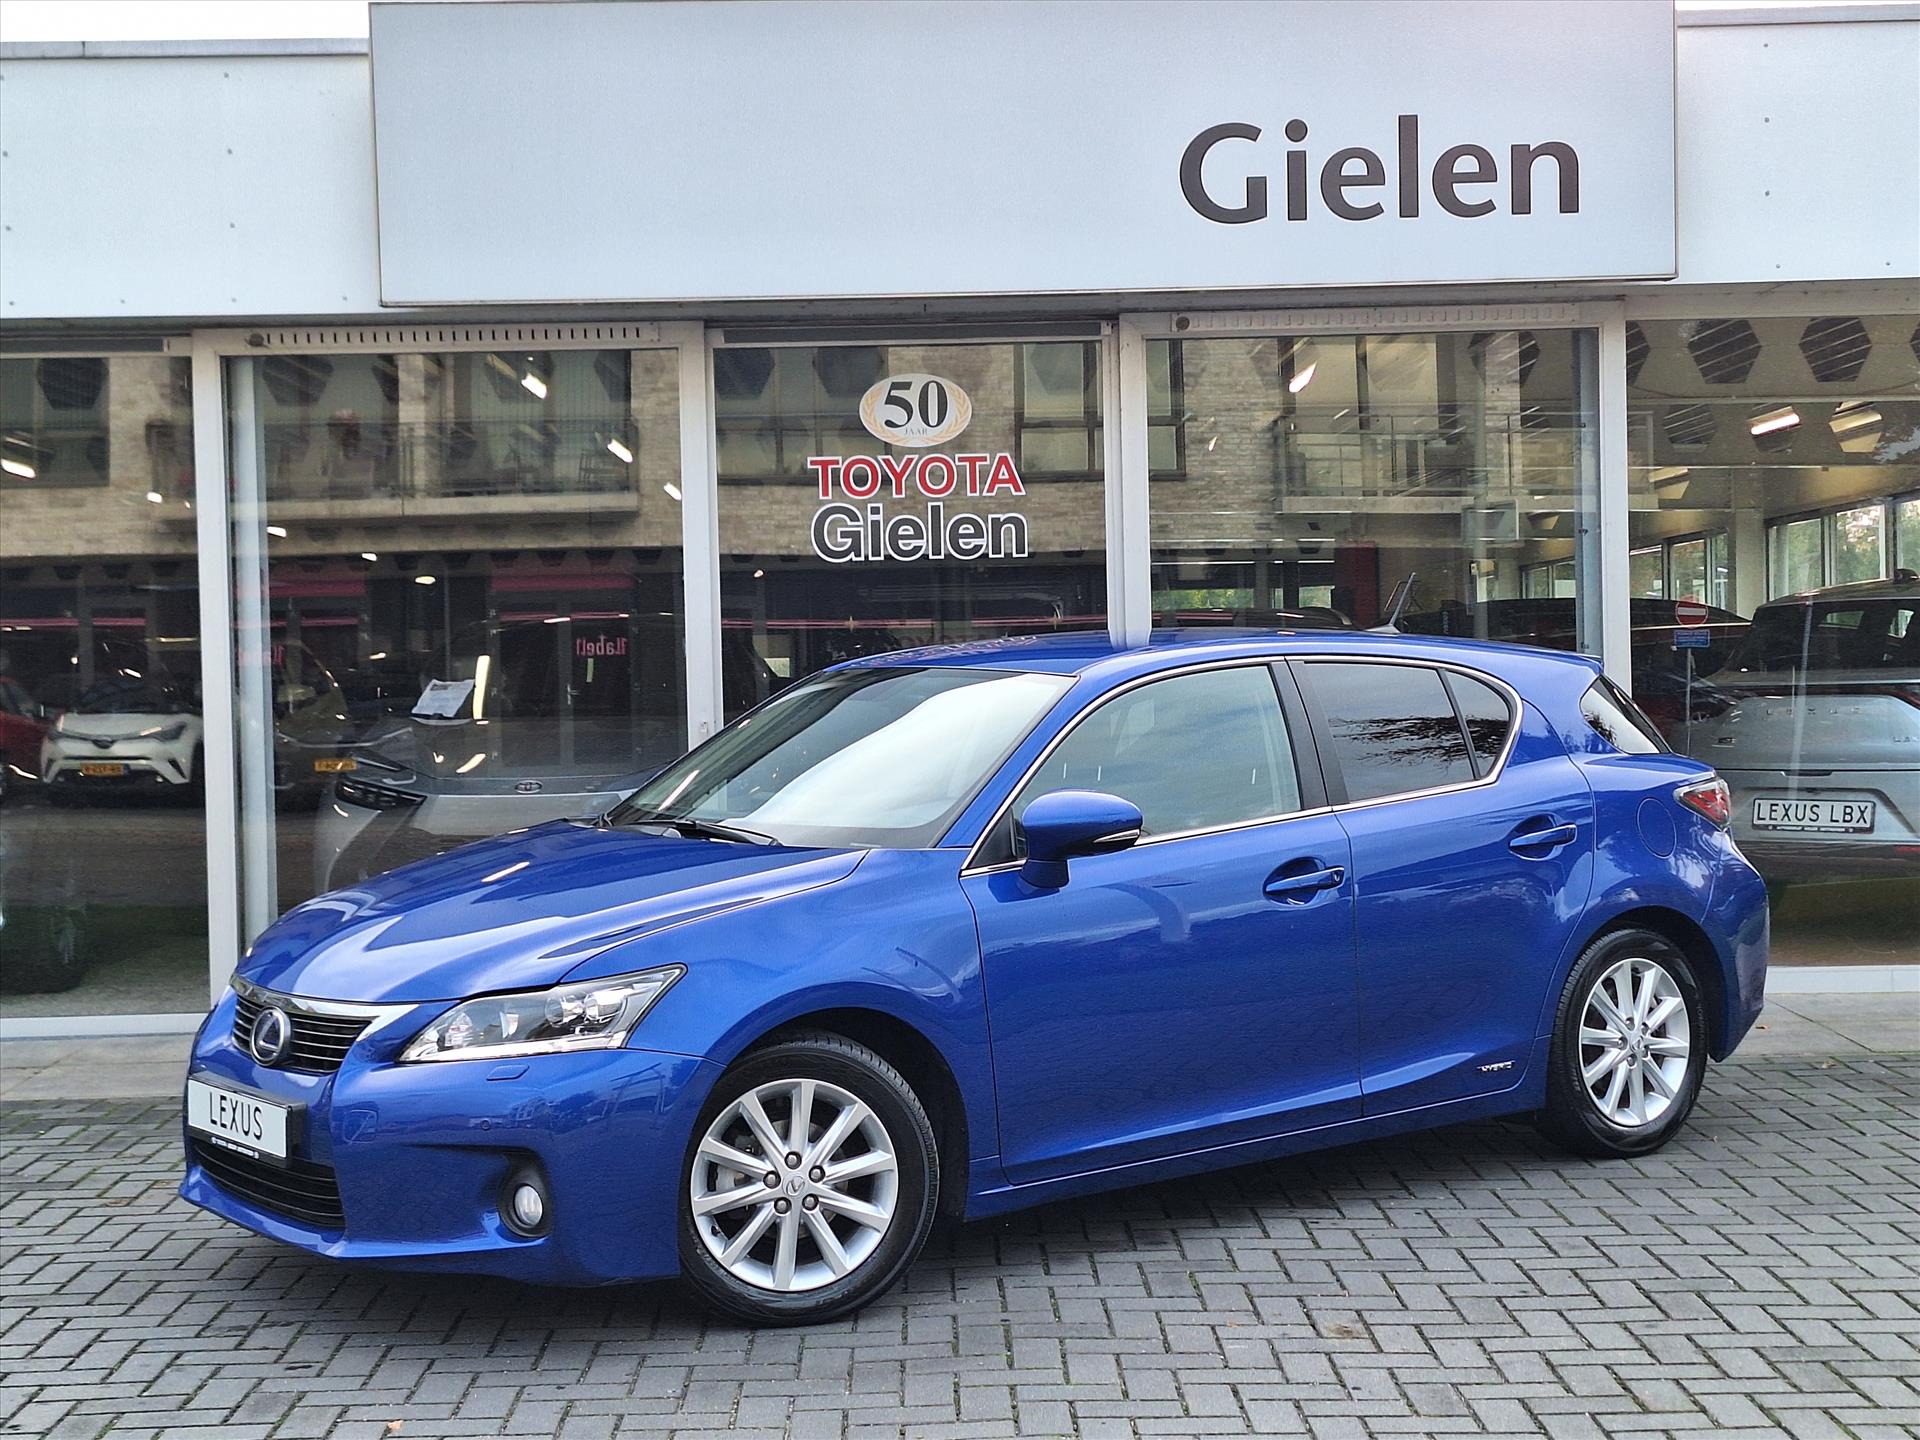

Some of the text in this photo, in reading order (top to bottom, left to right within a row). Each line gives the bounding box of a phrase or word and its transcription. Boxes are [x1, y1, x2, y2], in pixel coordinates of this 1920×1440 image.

[1179, 114, 1580, 224] Gielen
[884, 380, 948, 429] 50
[905, 427, 928, 435] JAAR
[807, 453, 1026, 499] TOYOTA
[811, 502, 1029, 563] Gielen
[1757, 802, 1869, 824] LEXUS LBX
[209, 1091, 263, 1141] LEXUS
